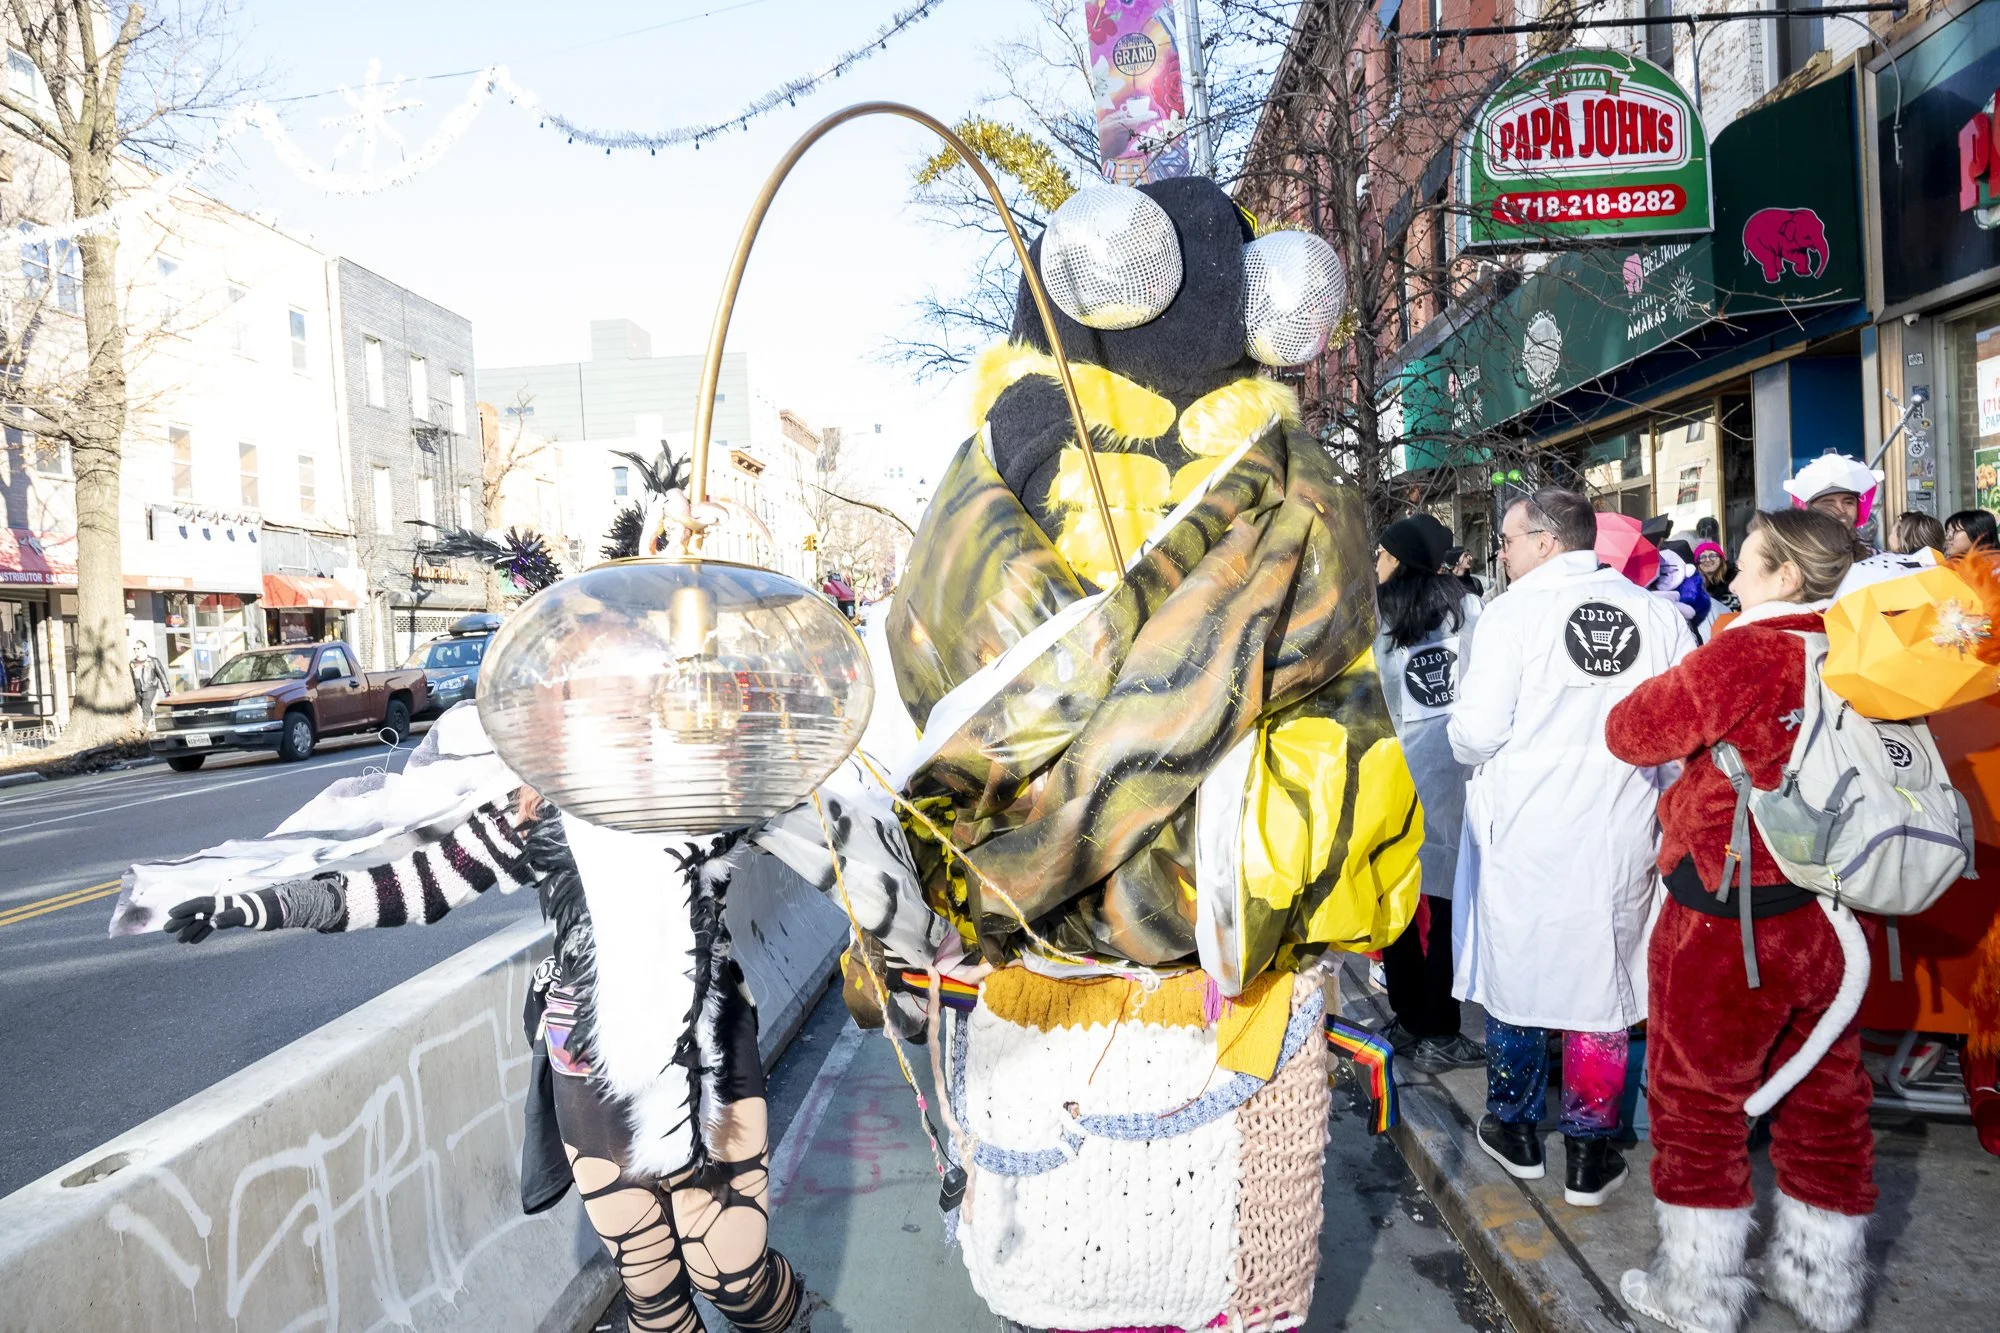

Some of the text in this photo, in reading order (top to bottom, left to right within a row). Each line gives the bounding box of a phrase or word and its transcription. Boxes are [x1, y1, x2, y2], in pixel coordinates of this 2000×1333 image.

[1114, 46, 1155, 66] GRAND
[1562, 71, 1607, 89] PIZZA
[1499, 98, 1674, 162] PAPA JOHN'S
[1517, 189, 1676, 218] 718-218-8282
[1579, 608, 1623, 623] IDIOT
[1412, 651, 1449, 668] IDIOT
[1584, 658, 1621, 673] LABS
[1425, 689, 1456, 706] LABS
